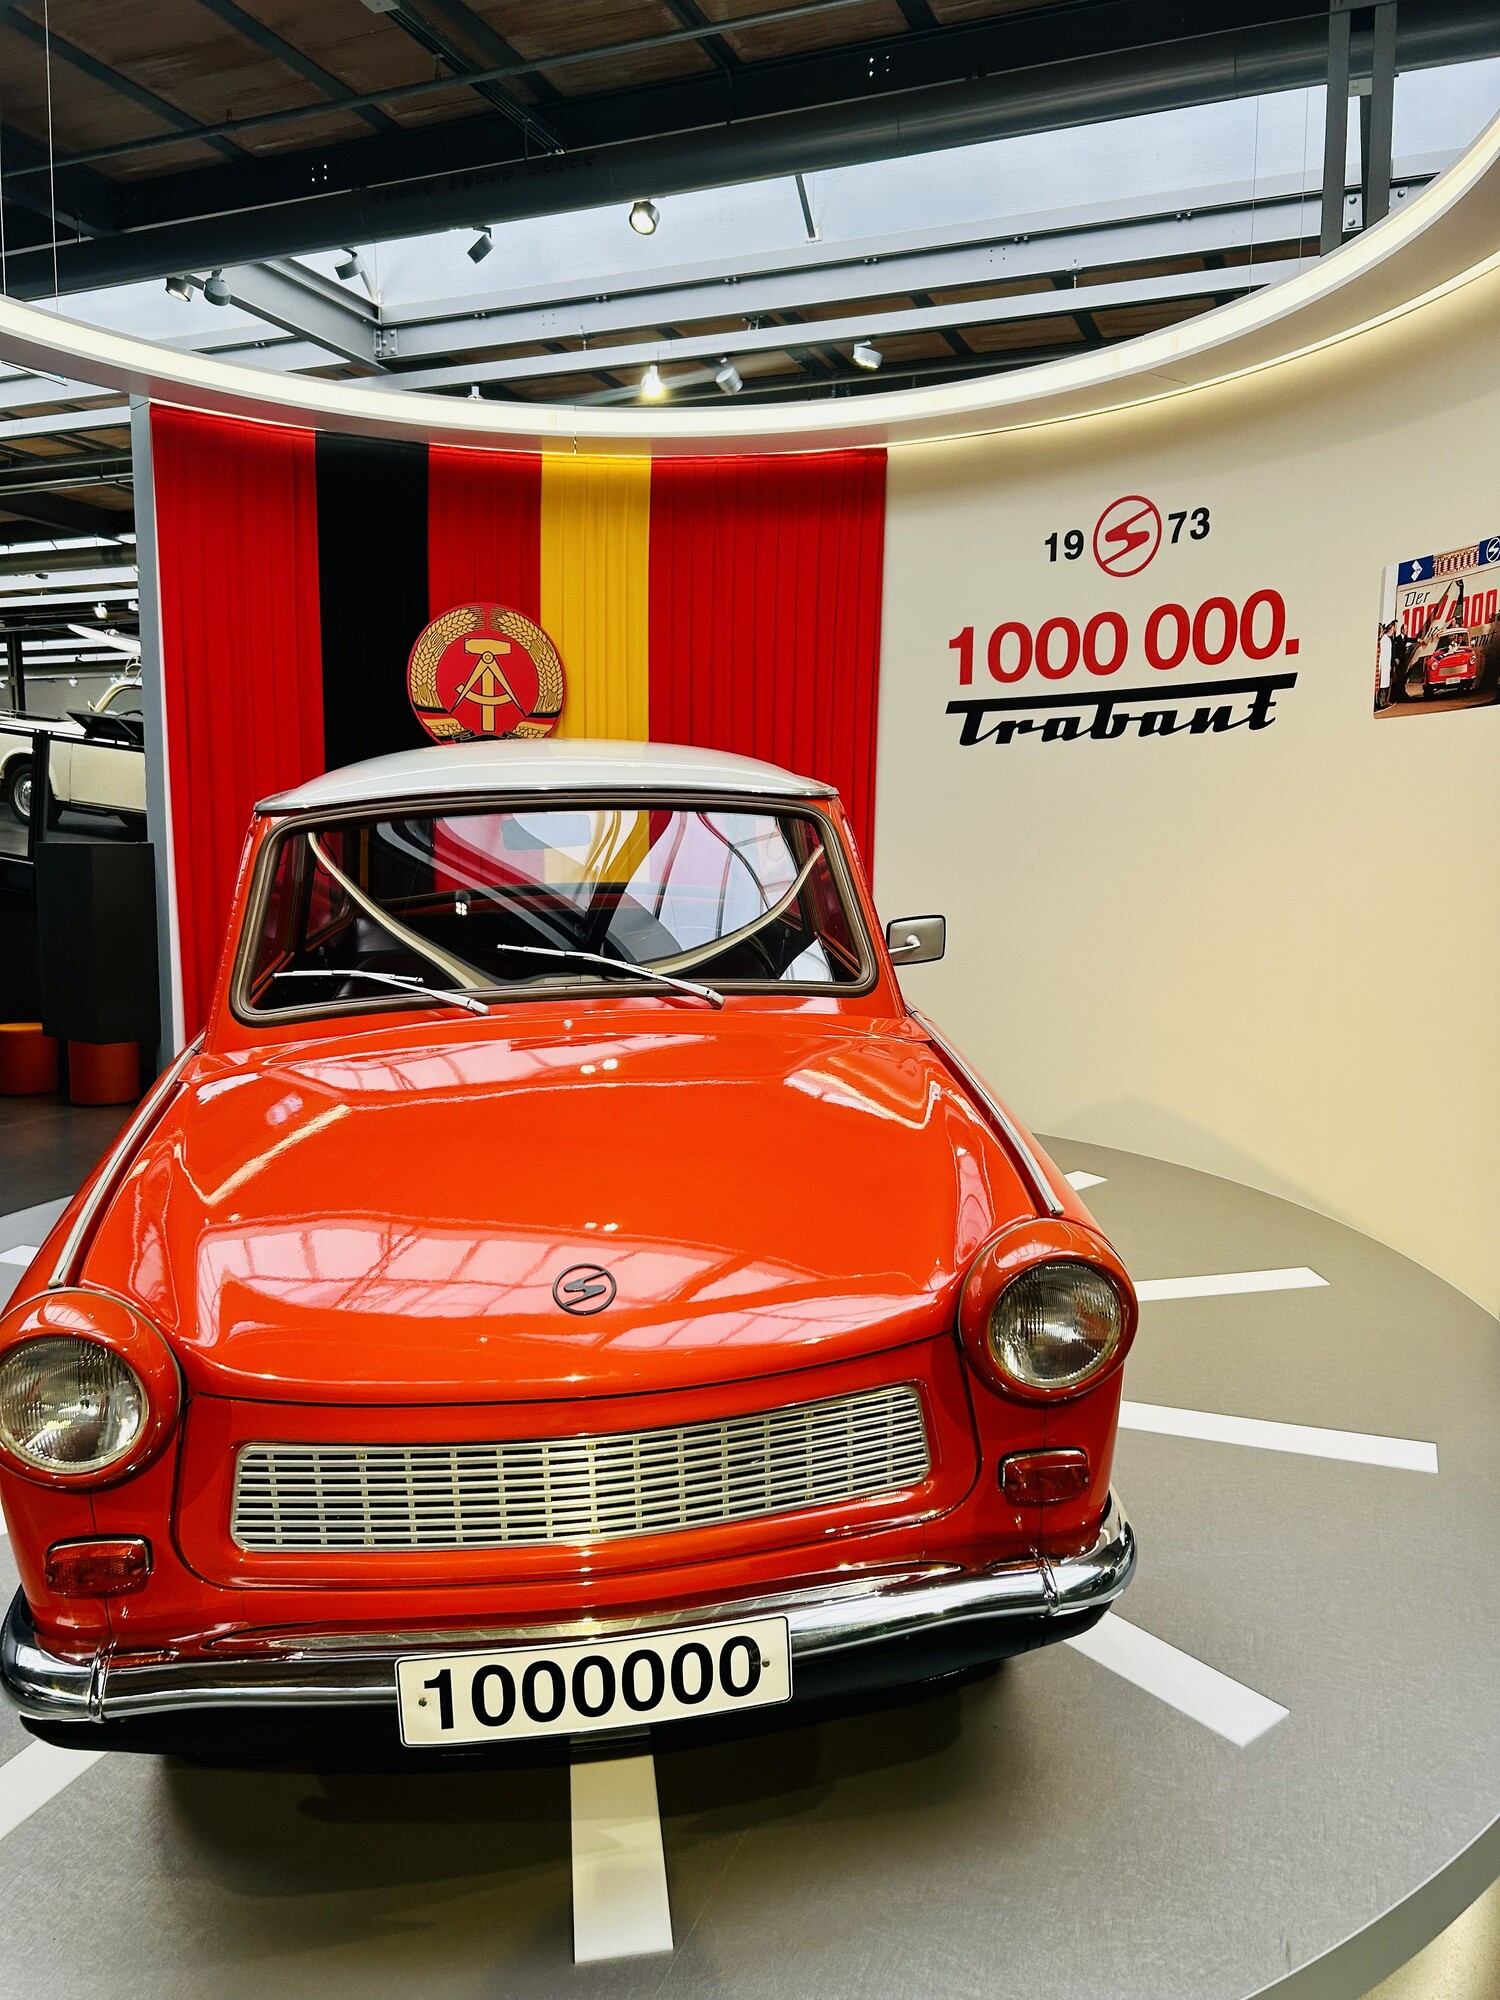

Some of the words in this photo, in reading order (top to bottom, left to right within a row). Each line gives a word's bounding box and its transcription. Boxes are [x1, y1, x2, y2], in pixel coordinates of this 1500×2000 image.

[1044, 529, 1085, 563] 19
[1167, 507, 1211, 545] 73
[1404, 591, 1431, 608] Der
[945, 672, 1299, 747] Trabant
[423, 1635, 761, 1731] 1000000
